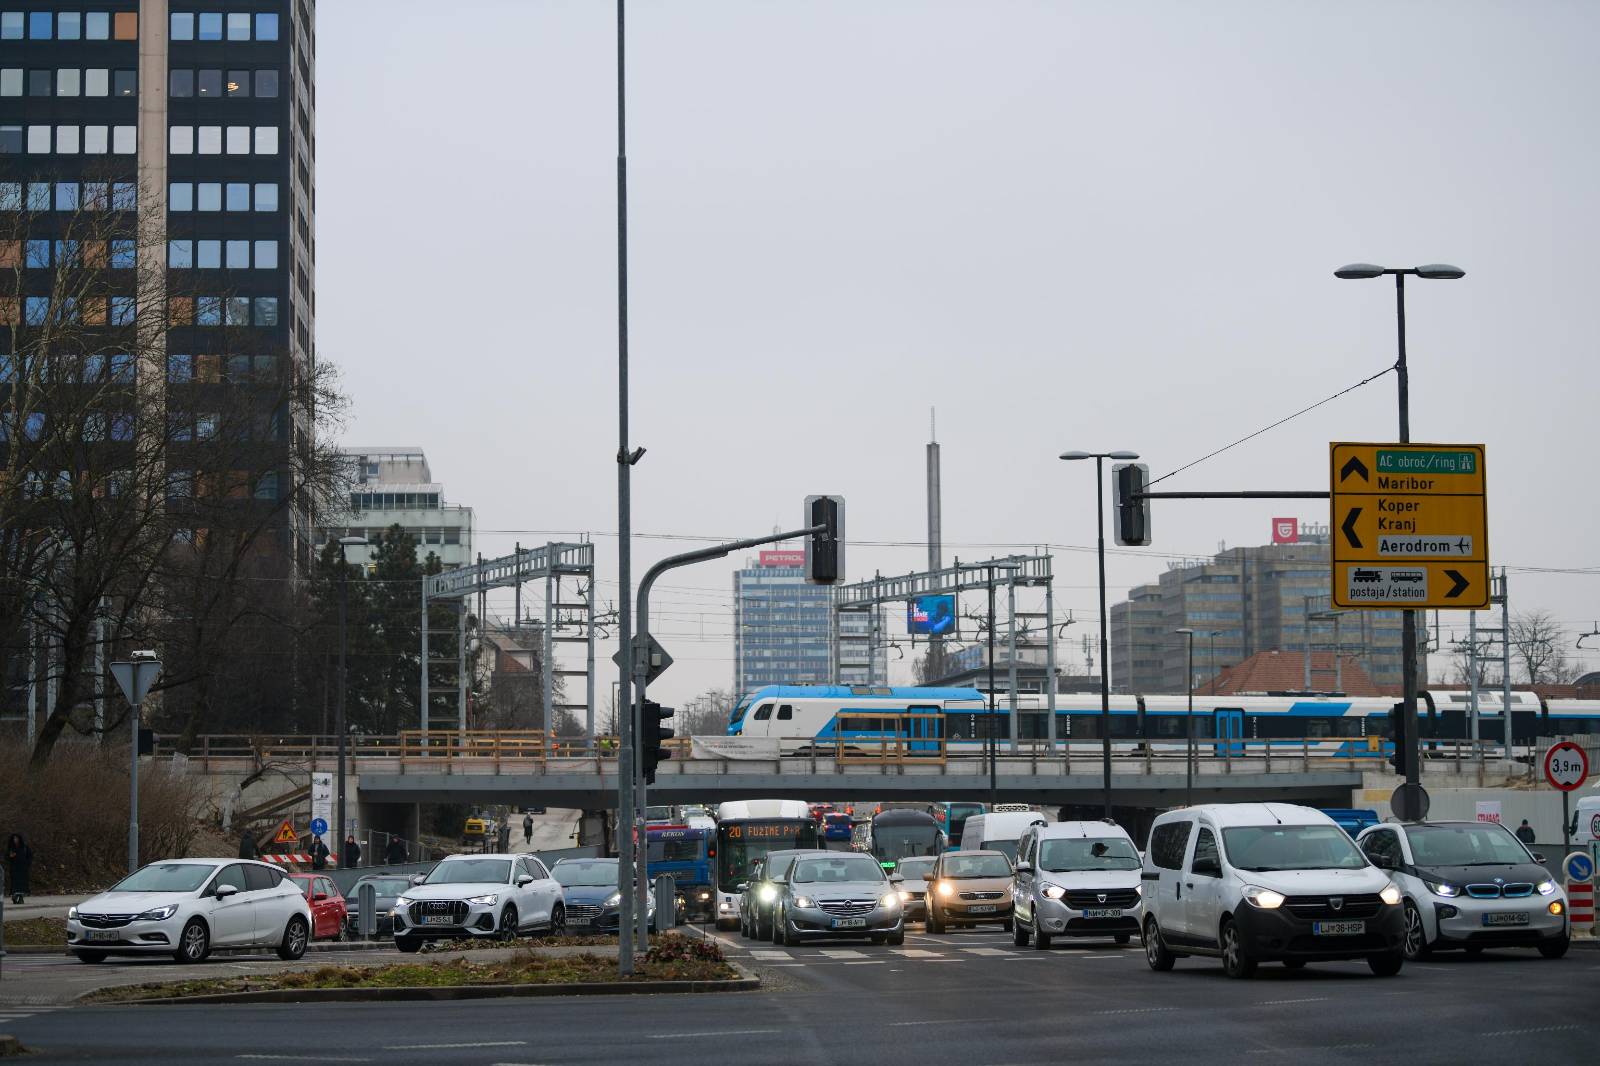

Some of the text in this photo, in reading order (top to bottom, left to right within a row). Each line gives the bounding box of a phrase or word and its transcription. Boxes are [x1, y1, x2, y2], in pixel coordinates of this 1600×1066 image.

[1380, 455, 1393, 467] AC
[1378, 476, 1434, 490] Maribor
[1378, 499, 1420, 515] Koper
[1378, 517, 1417, 534] Kranj
[1380, 539, 1451, 553] Aerodrom
[1350, 585, 1426, 600] postaja/station
[1552, 758, 1581, 774] 3,9 m
[728, 825, 742, 839] 20
